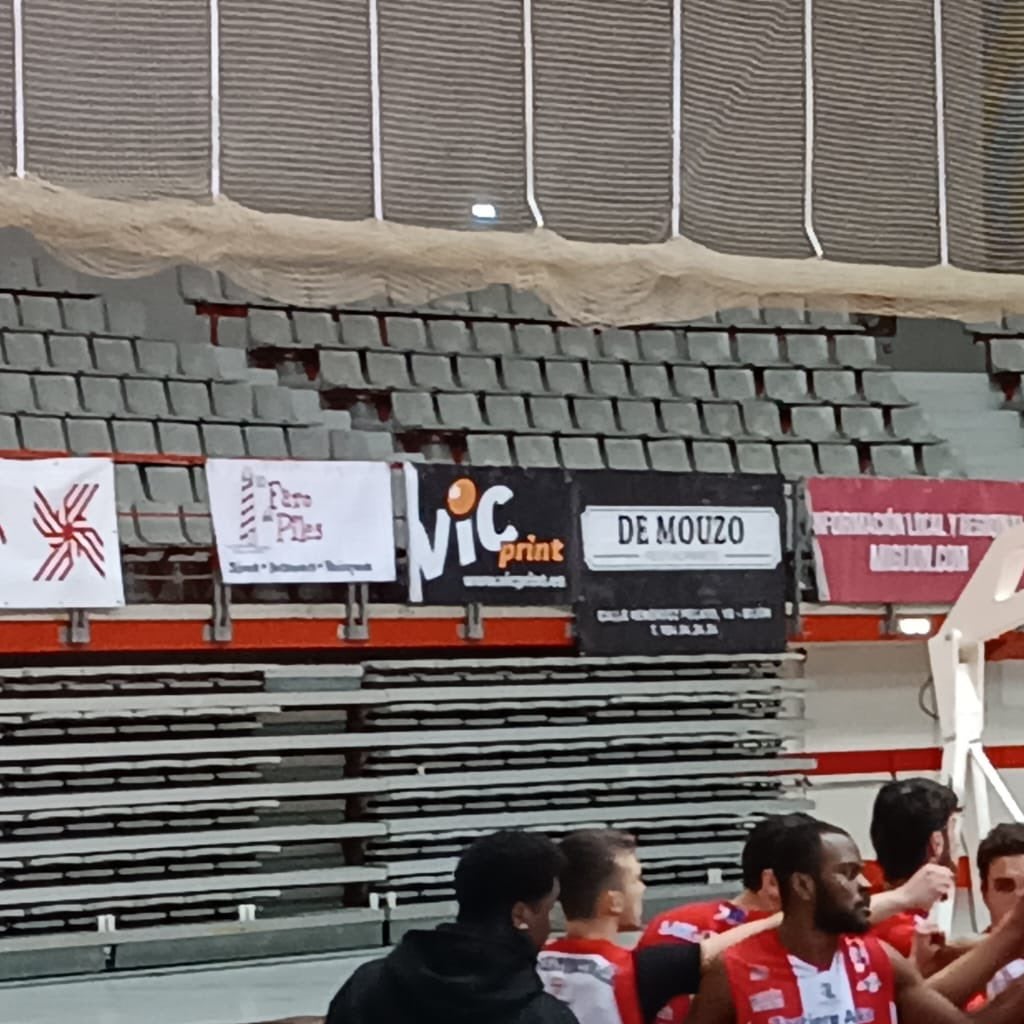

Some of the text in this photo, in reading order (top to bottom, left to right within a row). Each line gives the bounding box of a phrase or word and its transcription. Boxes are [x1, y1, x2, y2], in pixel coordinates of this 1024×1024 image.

[618, 514, 745, 545] DE MOUZO
[498, 534, 564, 568] print
